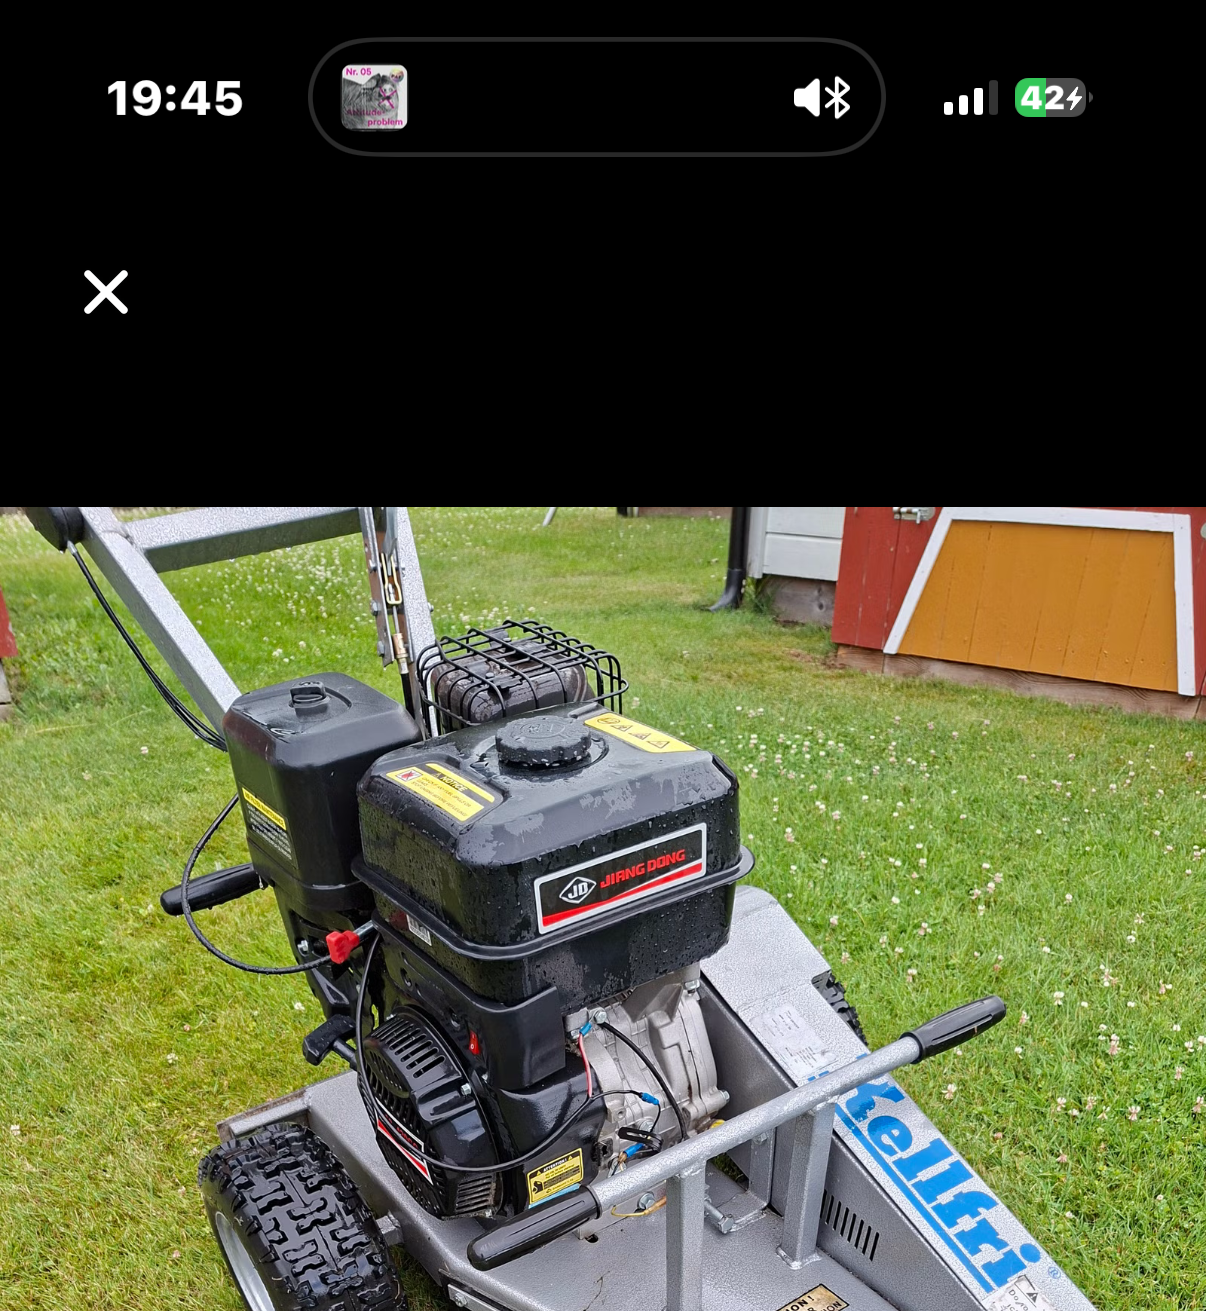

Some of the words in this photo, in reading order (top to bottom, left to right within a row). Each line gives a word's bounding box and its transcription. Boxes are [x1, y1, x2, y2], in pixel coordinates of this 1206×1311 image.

[440, 776, 468, 792] NOTICE
[600, 862, 645, 889] JIANG
[647, 849, 686, 873] DONG
[567, 881, 589, 899] JD
